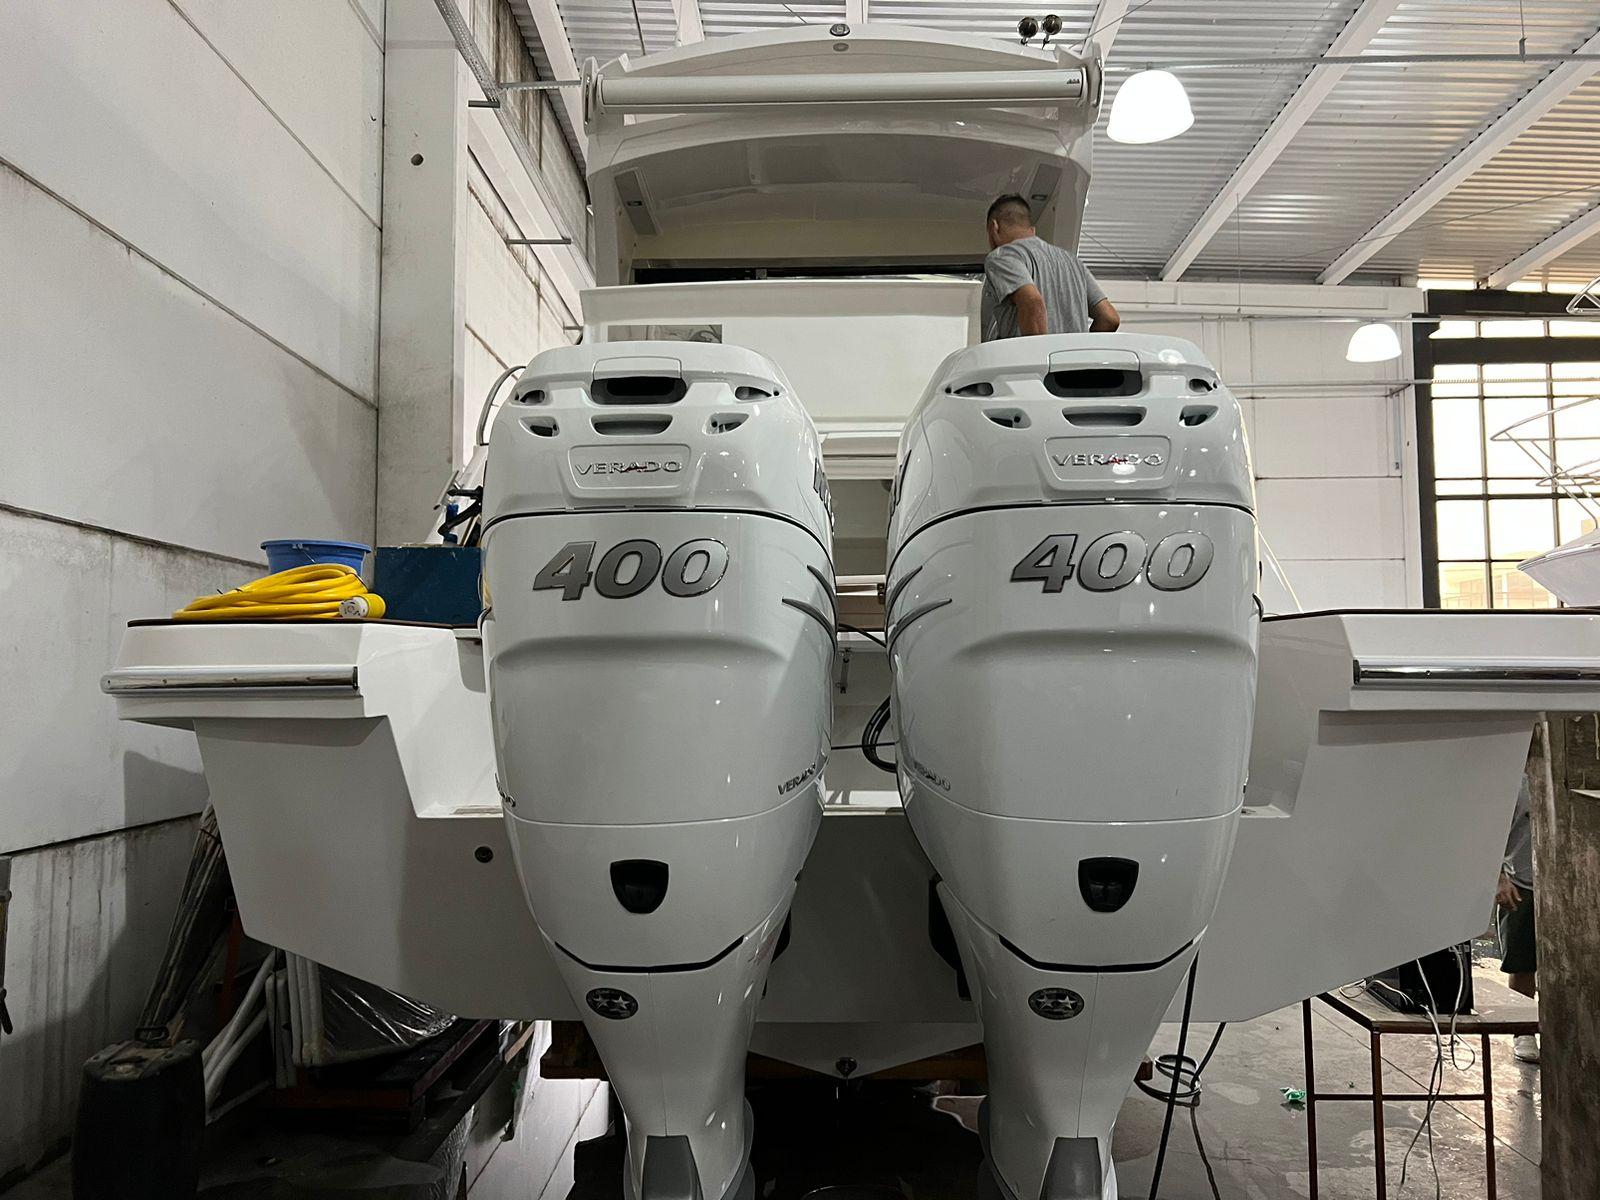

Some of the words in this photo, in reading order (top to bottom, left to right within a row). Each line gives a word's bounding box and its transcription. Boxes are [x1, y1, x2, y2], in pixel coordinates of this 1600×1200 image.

[575, 461, 682, 475] VERADO
[1051, 453, 1164, 467] VERADO
[533, 537, 730, 601] 400
[1010, 530, 1214, 594] 400
